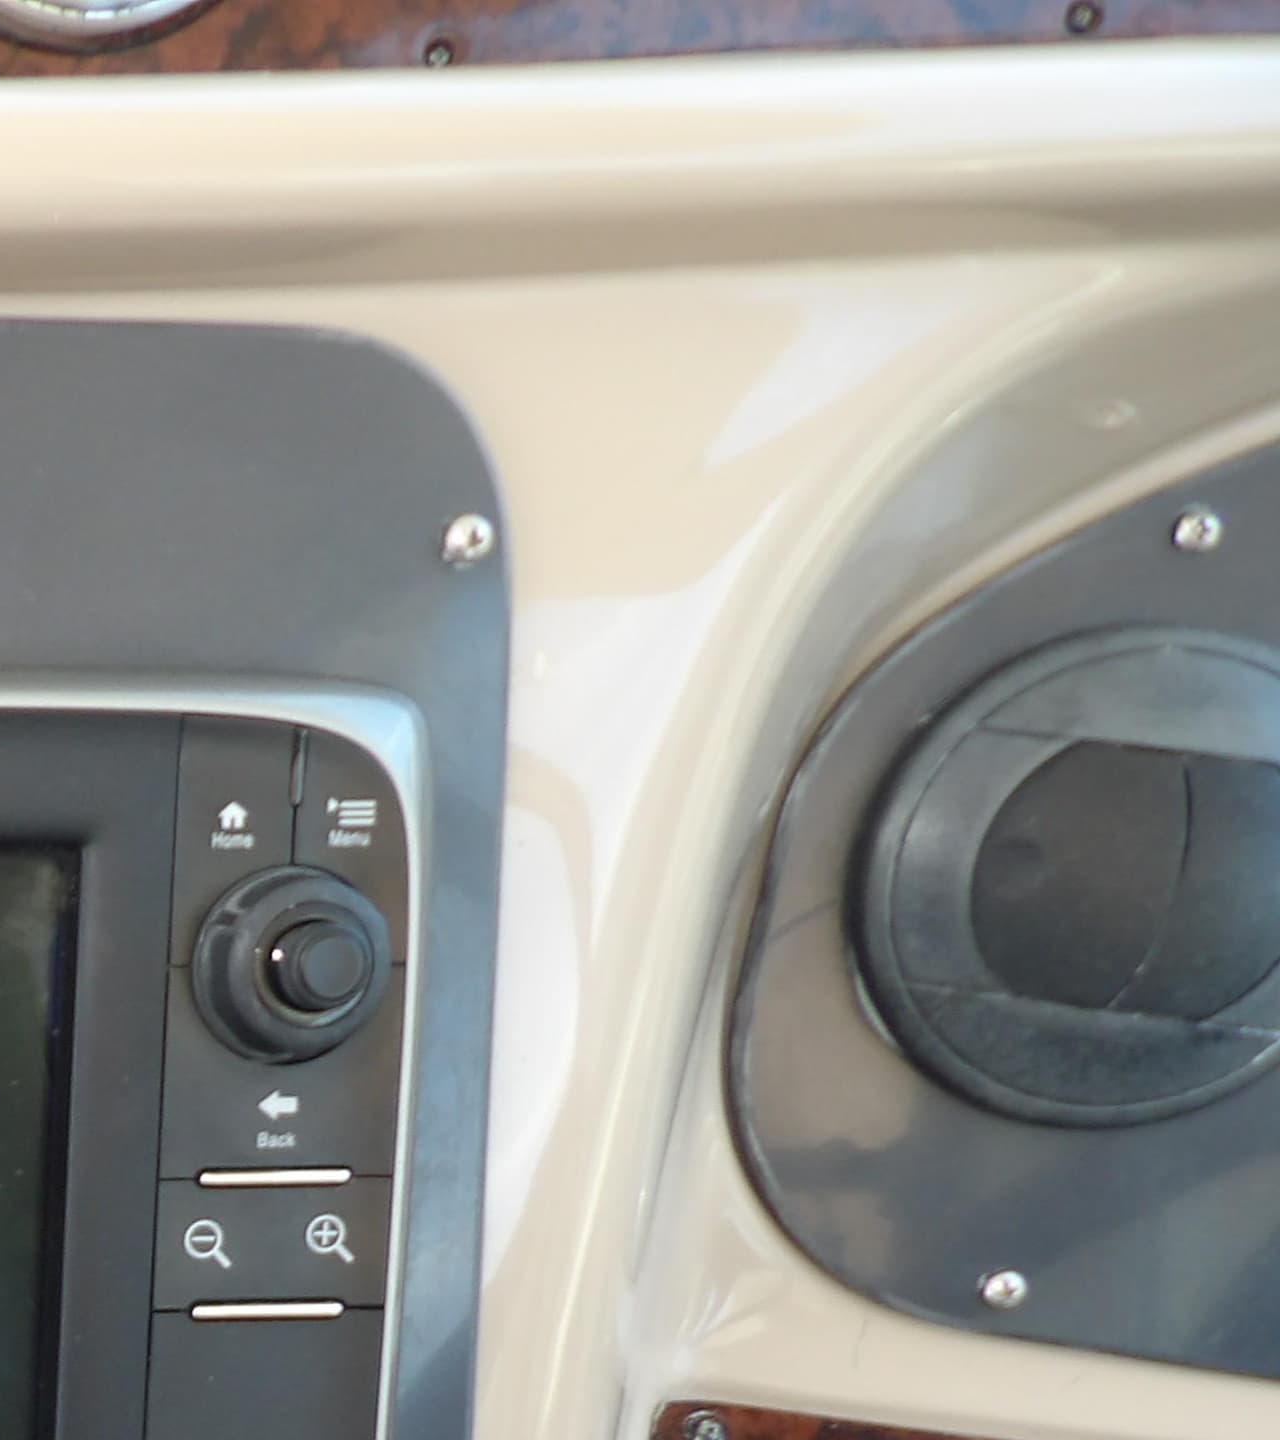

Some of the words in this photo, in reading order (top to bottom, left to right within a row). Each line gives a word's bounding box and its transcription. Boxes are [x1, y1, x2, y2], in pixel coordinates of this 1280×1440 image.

[211, 832, 255, 849] Home
[328, 829, 371, 847] Menu
[256, 1132, 296, 1149] Back
